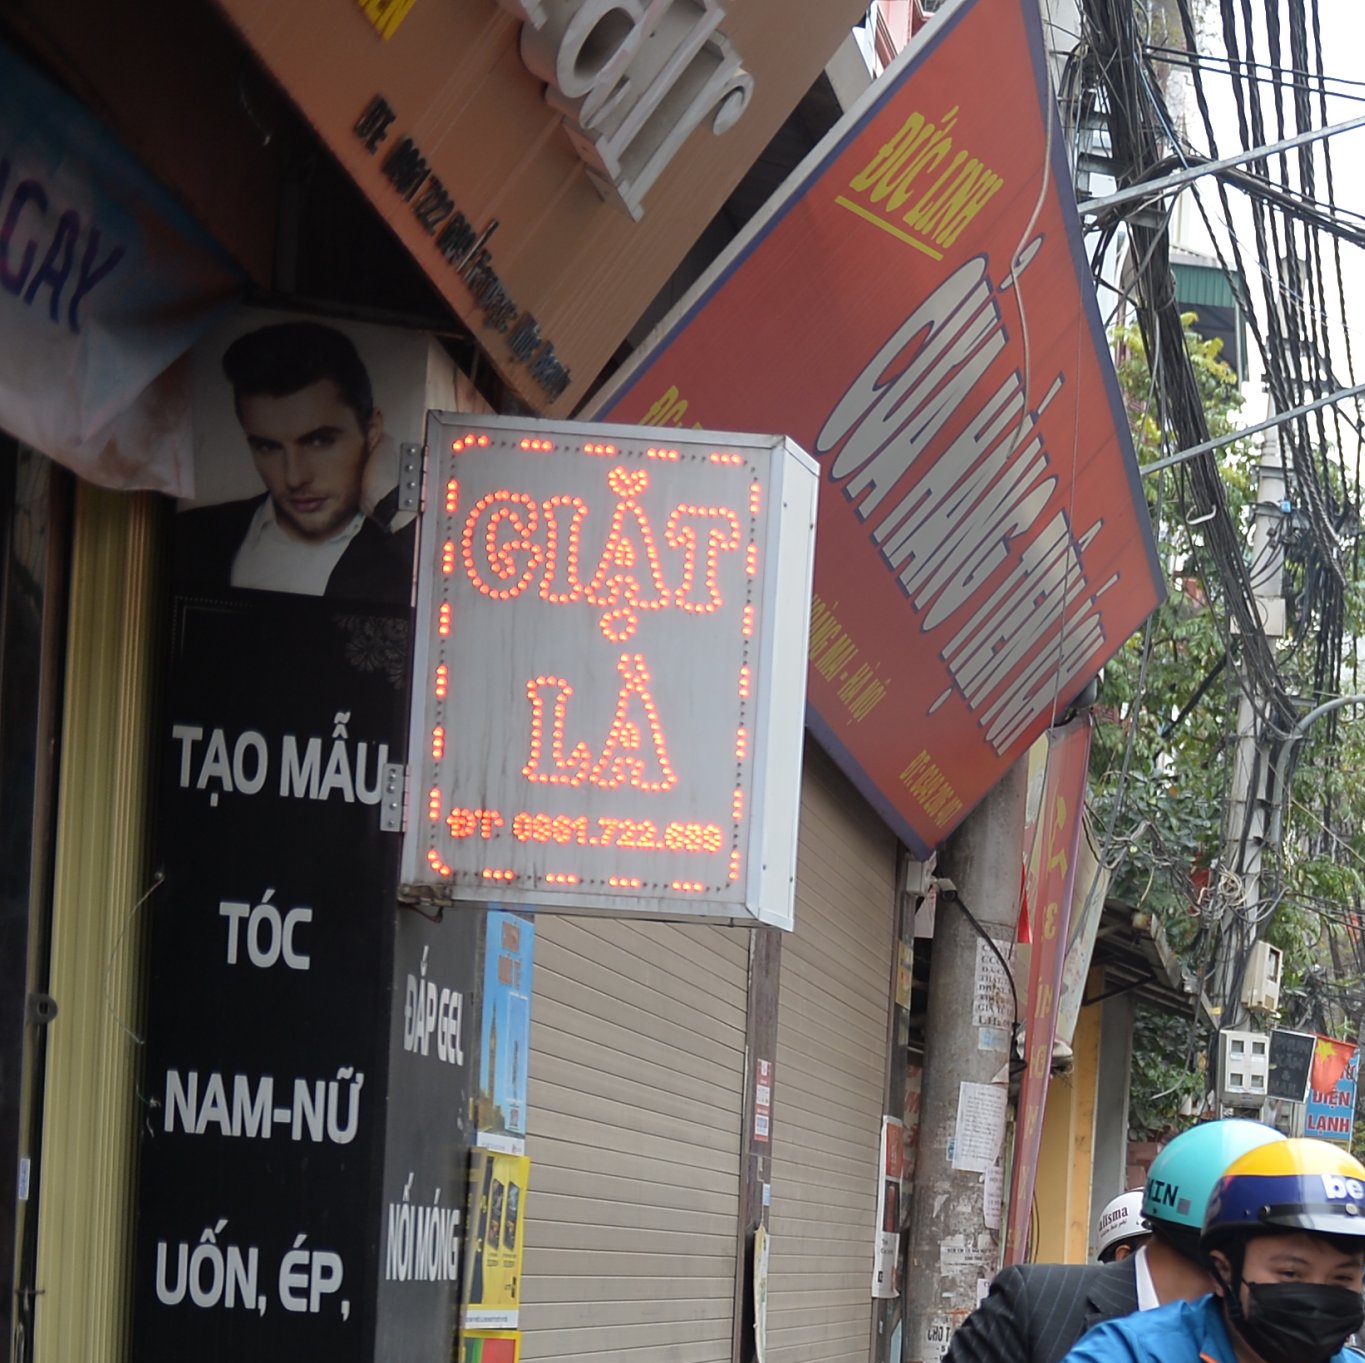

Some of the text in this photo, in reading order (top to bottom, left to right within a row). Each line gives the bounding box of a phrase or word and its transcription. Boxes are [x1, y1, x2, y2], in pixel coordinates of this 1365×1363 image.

[849, 105, 1005, 250] ĐỨC LINH
[813, 232, 1120, 757] CỬA HÀNG TIỆN ÍCH
[172, 711, 389, 808] TẠO MẪU
[219, 889, 313, 970] TÓC
[438, 988, 464, 1066] GEL
[164, 1066, 364, 1145] NAM-NỮ
[1308, 1115, 1350, 1136] LẠNH
[385, 1173, 460, 1282] NỐI MÓNG
[1321, 1174, 1365, 1200] be
[155, 1218, 351, 1321] UỐN, ÉP,
